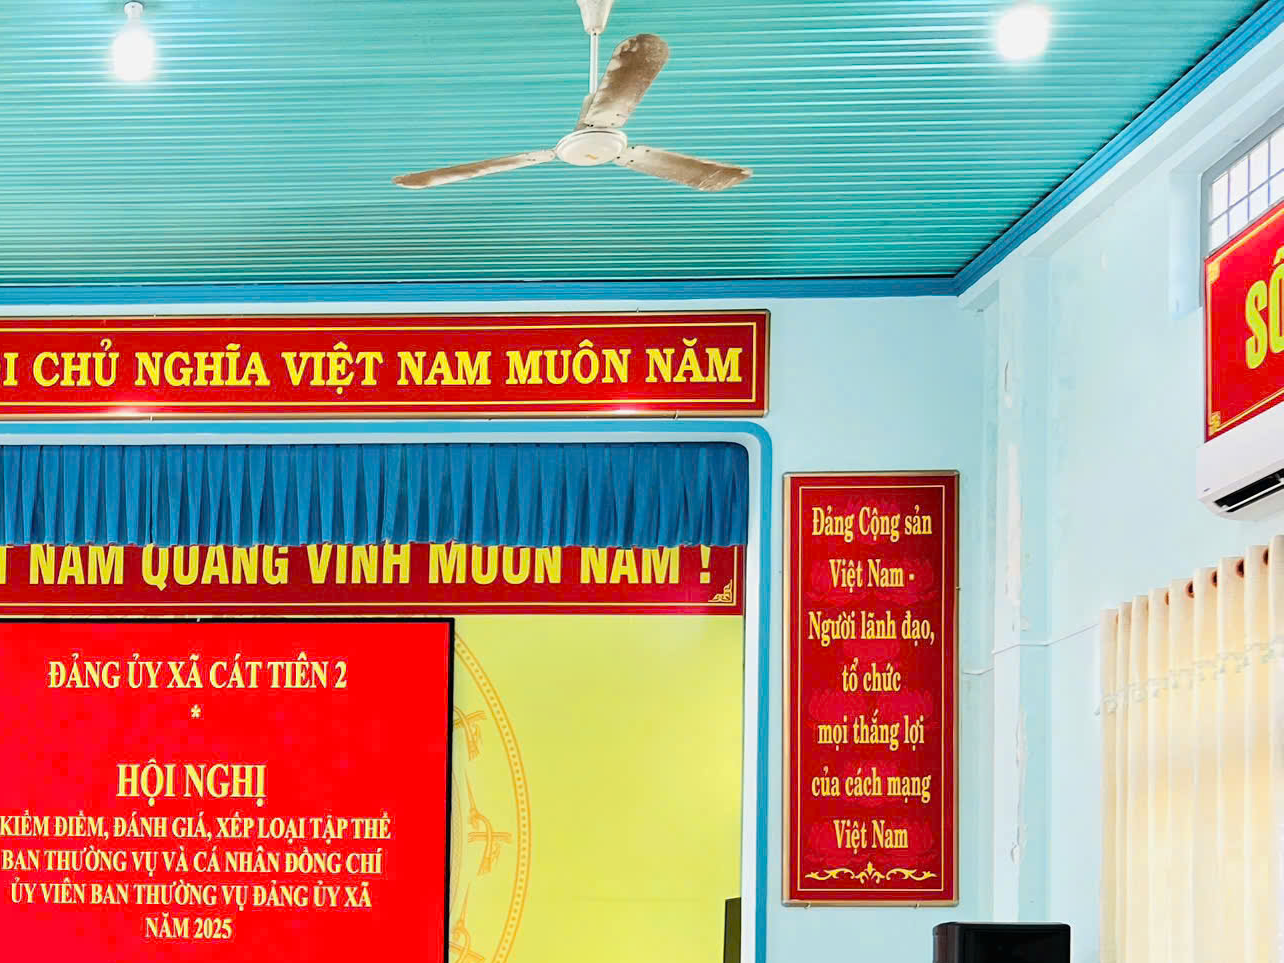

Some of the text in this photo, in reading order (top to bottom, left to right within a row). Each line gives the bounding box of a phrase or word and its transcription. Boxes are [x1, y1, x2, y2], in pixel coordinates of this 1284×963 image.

[33, 339, 119, 386] CHỦ
[135, 344, 270, 386] NGHĨA
[282, 342, 383, 394] VIỆT
[397, 352, 491, 385] NAM
[506, 339, 631, 384] MUÔN
[646, 338, 742, 382] NĂM
[812, 505, 932, 542] Đảng Cộng sản
[29, 543, 123, 585] NAM
[141, 543, 289, 591] QUANG
[307, 541, 410, 584] VINH
[829, 559, 862, 592] Việt
[868, 559, 904, 587] Nam
[808, 610, 934, 646] Người lãnh đạo,
[48, 652, 346, 688] ĐẢNG ỦY XÃ CÁT TIÊN 2
[842, 658, 900, 692] tổ chức
[818, 709, 924, 751] mọi thắng lợi
[116, 758, 266, 807] HỘI NGHỊ
[812, 766, 931, 803] của cách mạng
[0, 810, 391, 844] KIỂM ĐIỂM, ĐÁNH GIÁ, XẾP LOẠI TẬP THỂ
[834, 820, 908, 854] Việt Nam
[2, 845, 382, 877] BAN THƯỜNG VỤ VÀ CÁ NHÂN ĐỒNG CHÍ
[12, 877, 372, 911] ỦY VIÊN BAN THƯỜNG VỤ ĐẢNG ỦY XÃ
[146, 912, 232, 938] NĂM 2025
